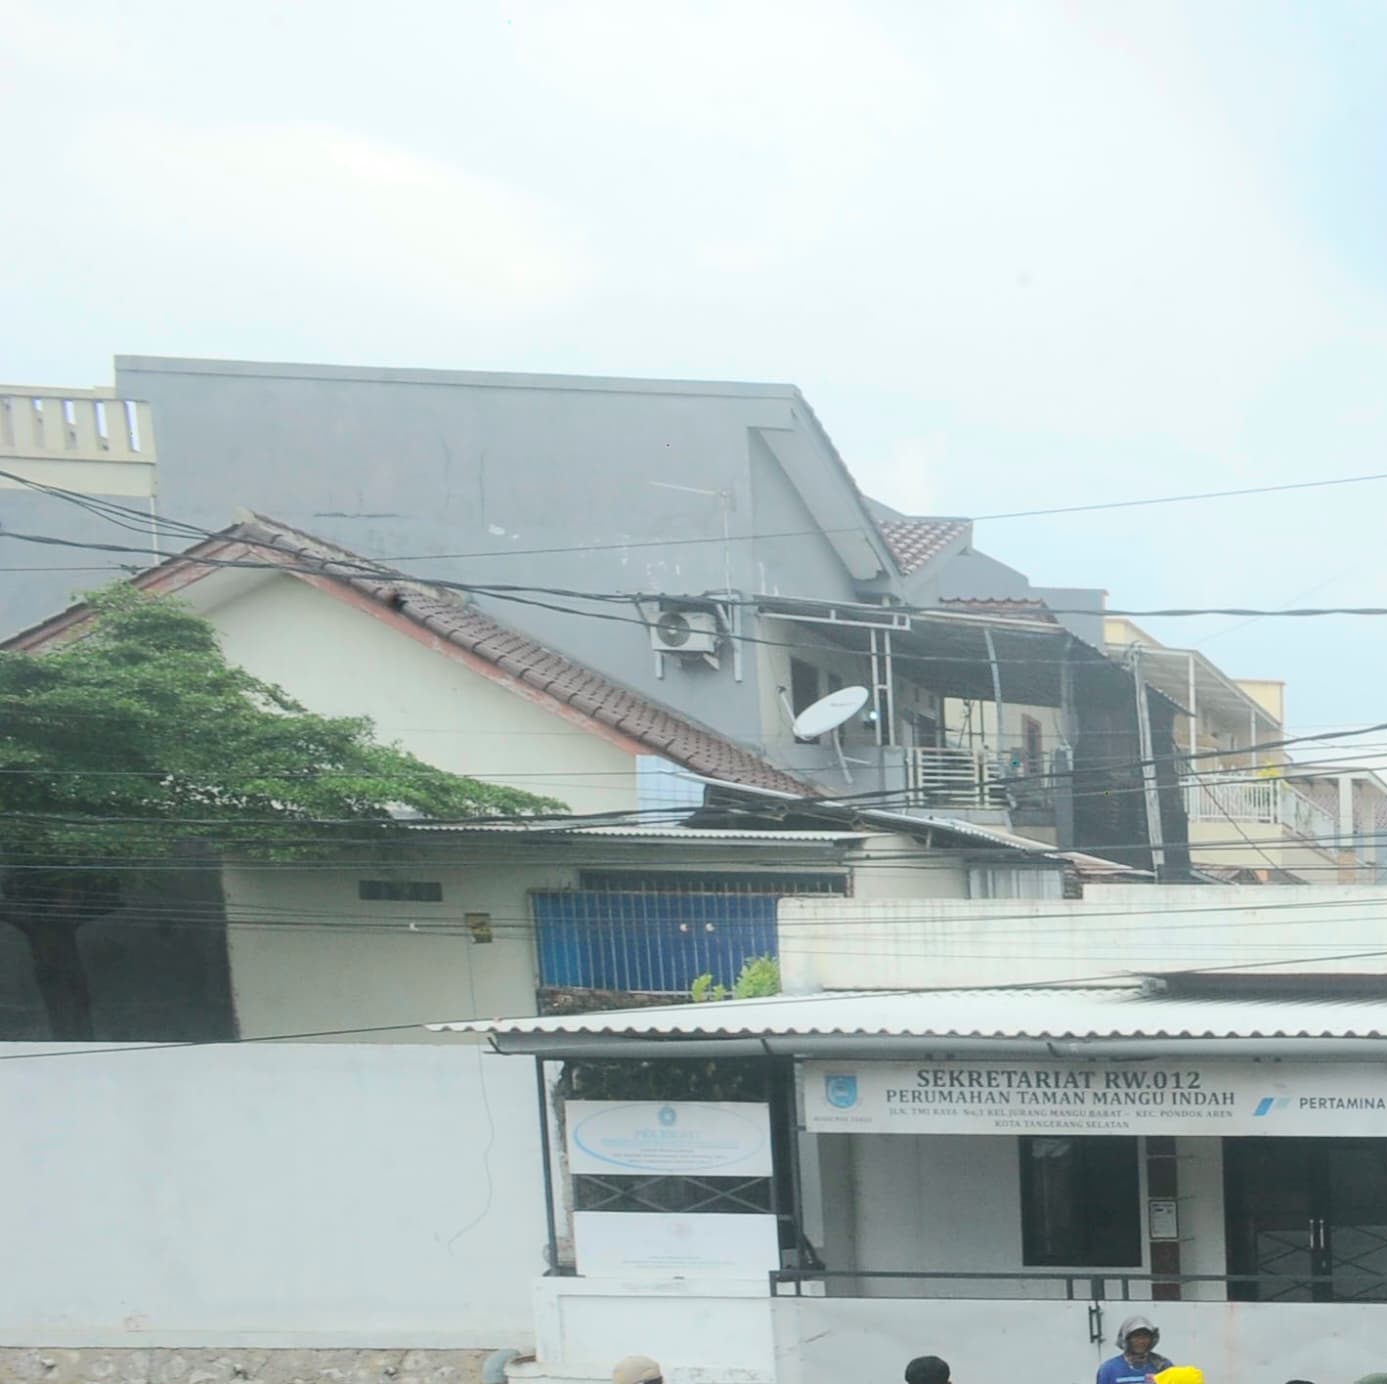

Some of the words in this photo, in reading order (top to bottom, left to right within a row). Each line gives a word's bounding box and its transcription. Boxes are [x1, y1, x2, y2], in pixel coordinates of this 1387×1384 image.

[917, 1070, 1095, 1089] SEKRETARIAT
[1104, 1071, 1201, 1090] RW.012
[886, 1089, 1011, 1104] PERUMAHAN
[1016, 1091, 1086, 1105] TAMAN
[1092, 1091, 1165, 1106] MANGU
[1172, 1091, 1235, 1105] INDAH
[1299, 1097, 1386, 1110] PERTAMINA
[995, 1120, 1021, 1129] KOTA
[1024, 1120, 1084, 1129] TANGERANG
[1085, 1120, 1129, 1129] SELATAN
